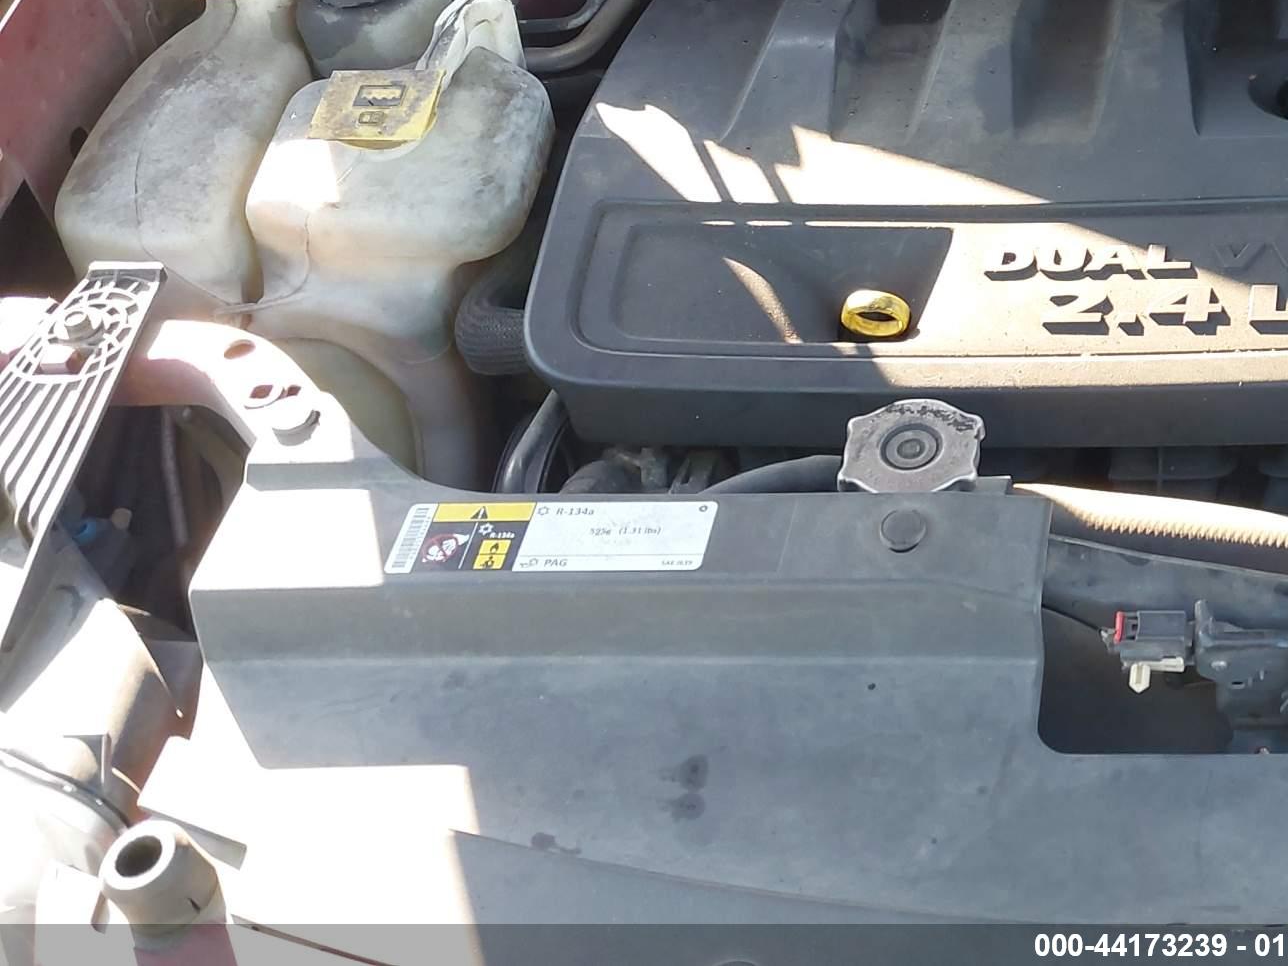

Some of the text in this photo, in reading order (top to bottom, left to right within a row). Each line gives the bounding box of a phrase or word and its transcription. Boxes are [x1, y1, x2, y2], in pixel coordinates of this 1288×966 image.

[984, 242, 1199, 281] DUAL
[555, 506, 596, 517] R-134a
[543, 558, 568, 568] PAG
